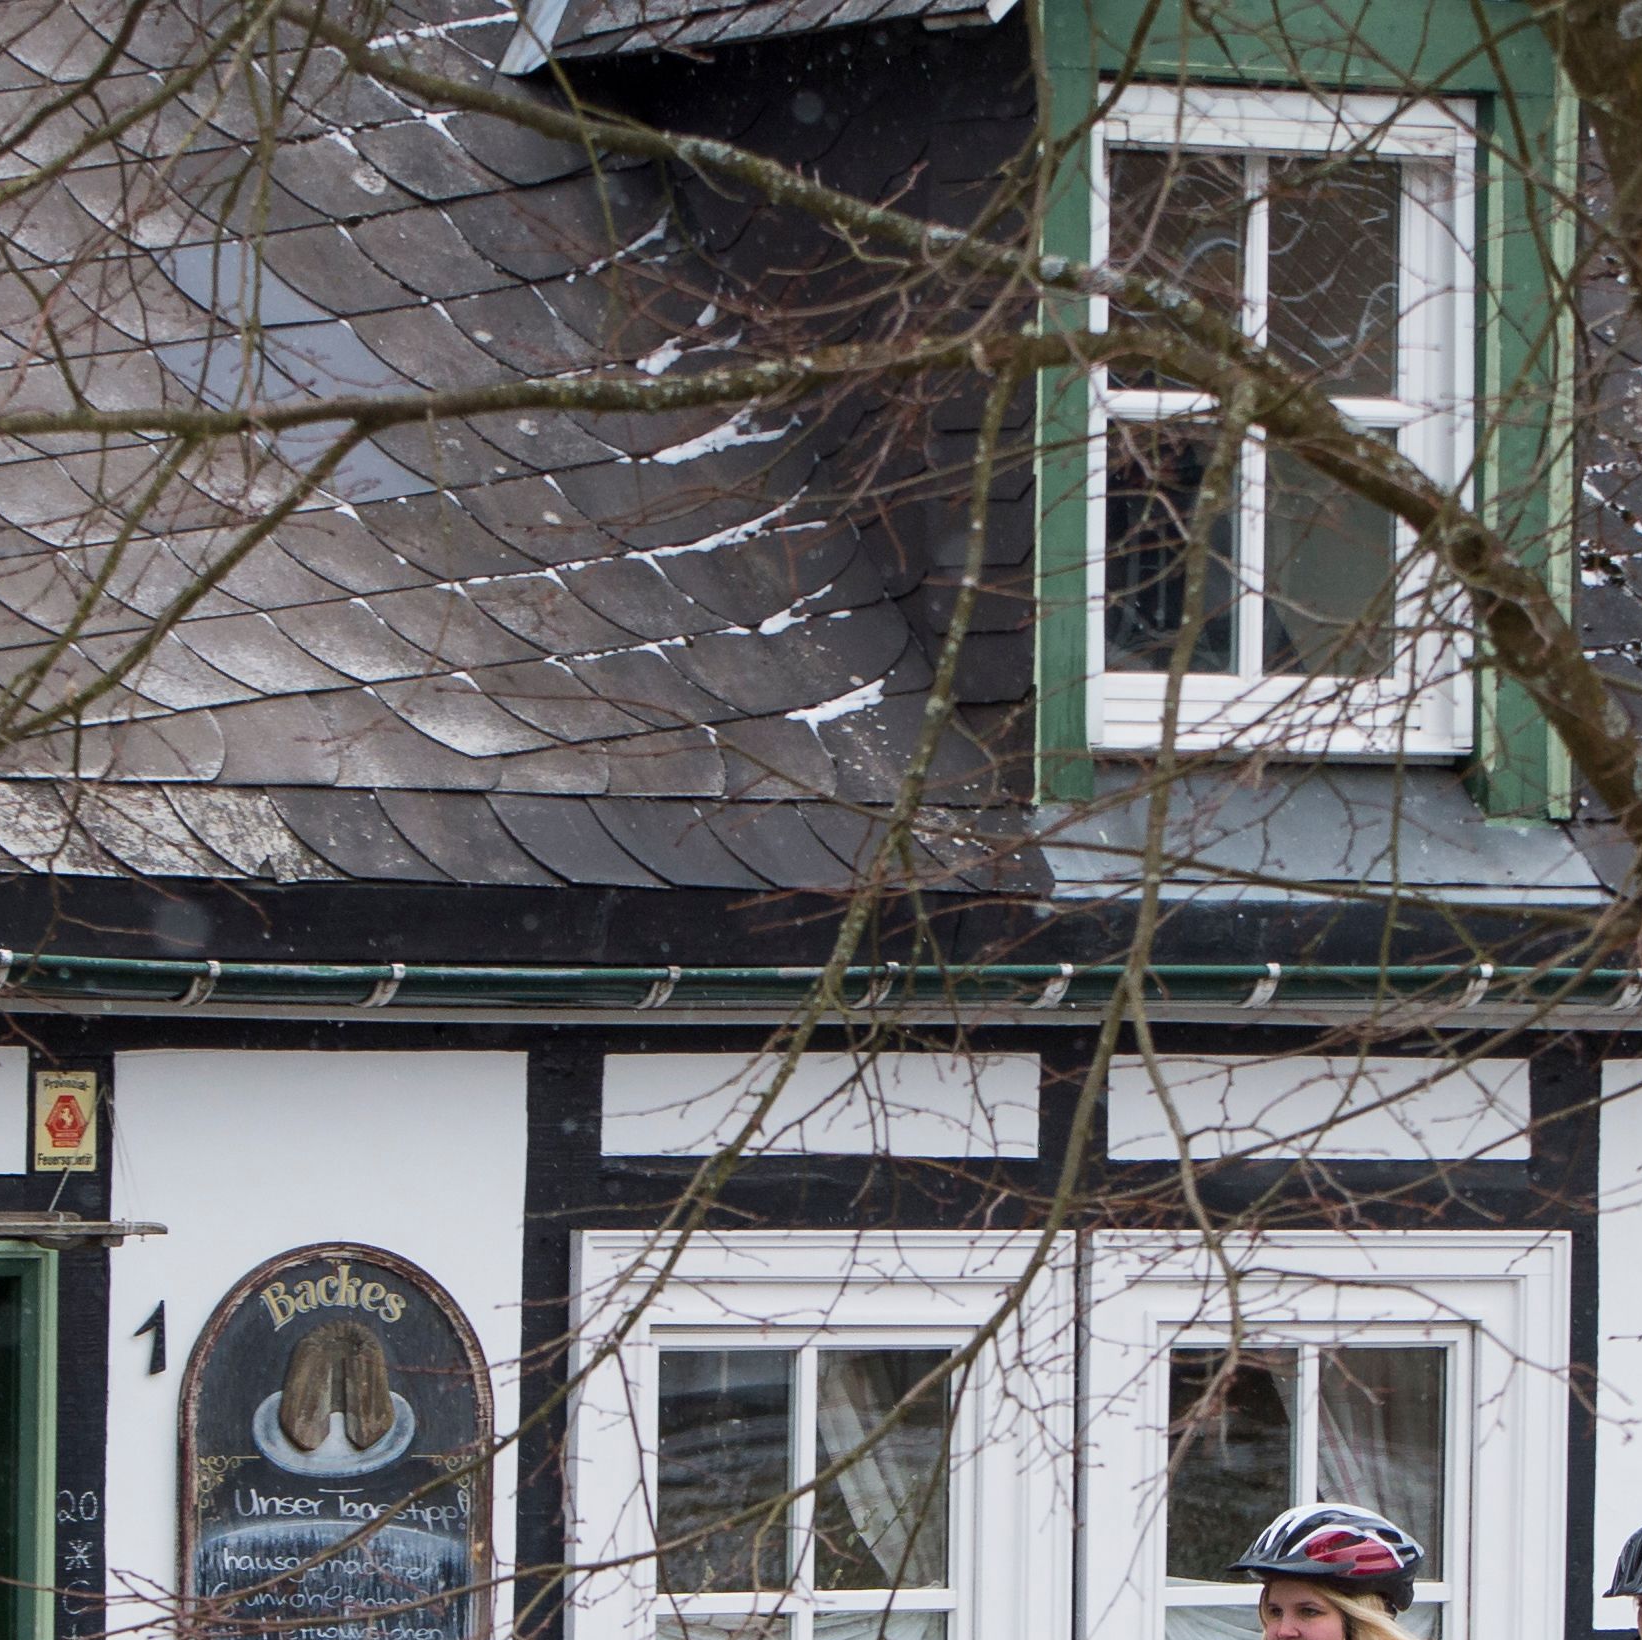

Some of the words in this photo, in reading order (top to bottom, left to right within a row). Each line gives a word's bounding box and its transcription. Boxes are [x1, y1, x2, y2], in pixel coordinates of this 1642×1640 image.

[261, 1265, 407, 1331] Backes
[134, 1300, 166, 1374] 1
[234, 1487, 324, 1518] Unser
